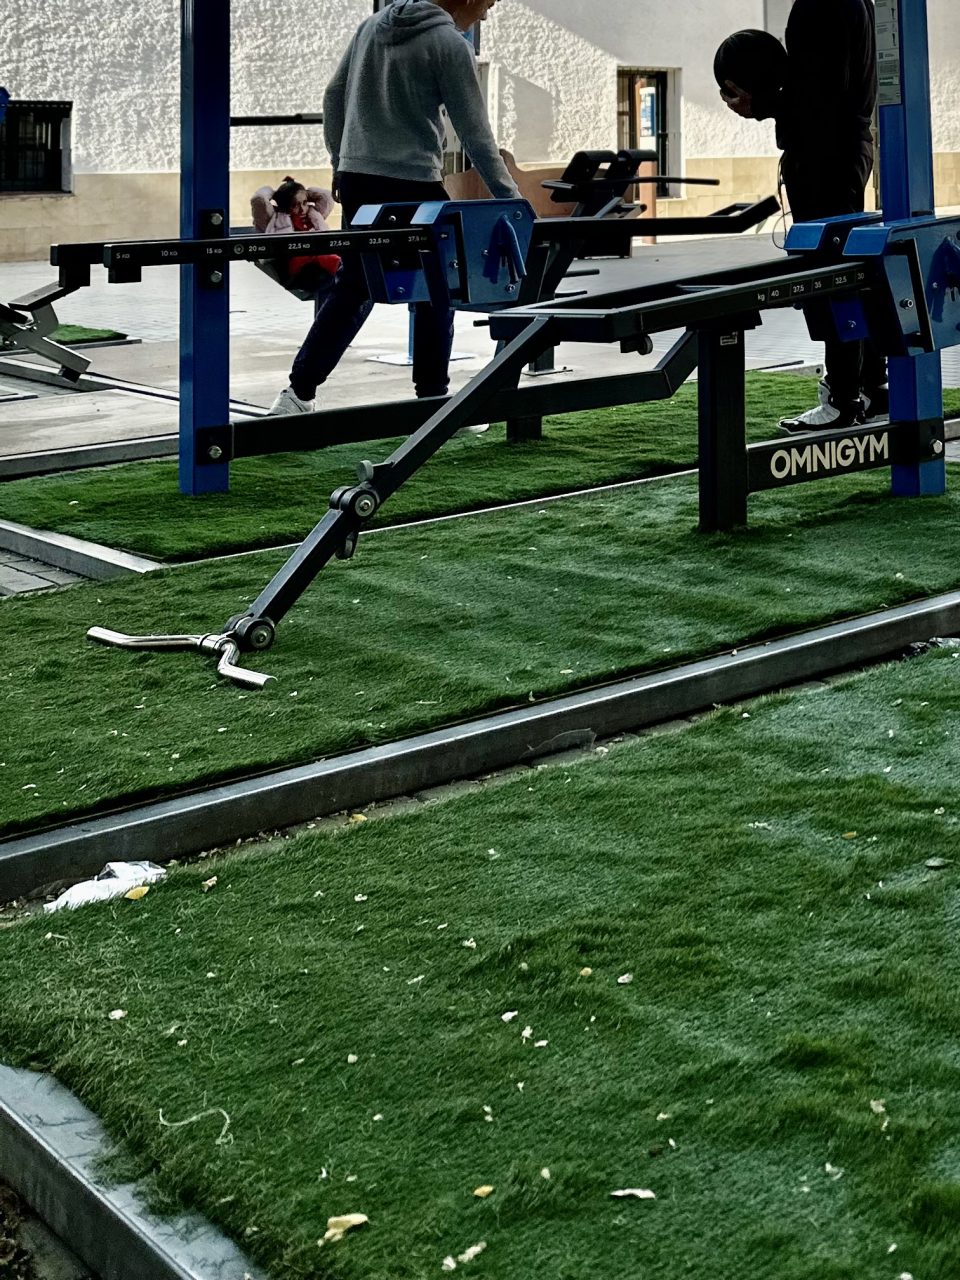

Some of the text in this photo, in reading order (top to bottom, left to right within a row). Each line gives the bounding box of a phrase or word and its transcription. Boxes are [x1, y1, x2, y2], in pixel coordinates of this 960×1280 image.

[757, 293, 766, 302] kg
[771, 289, 780, 297] 40
[814, 281, 822, 289] 35
[857, 272, 865, 280] 30
[770, 432, 889, 479] OMNIGYM
